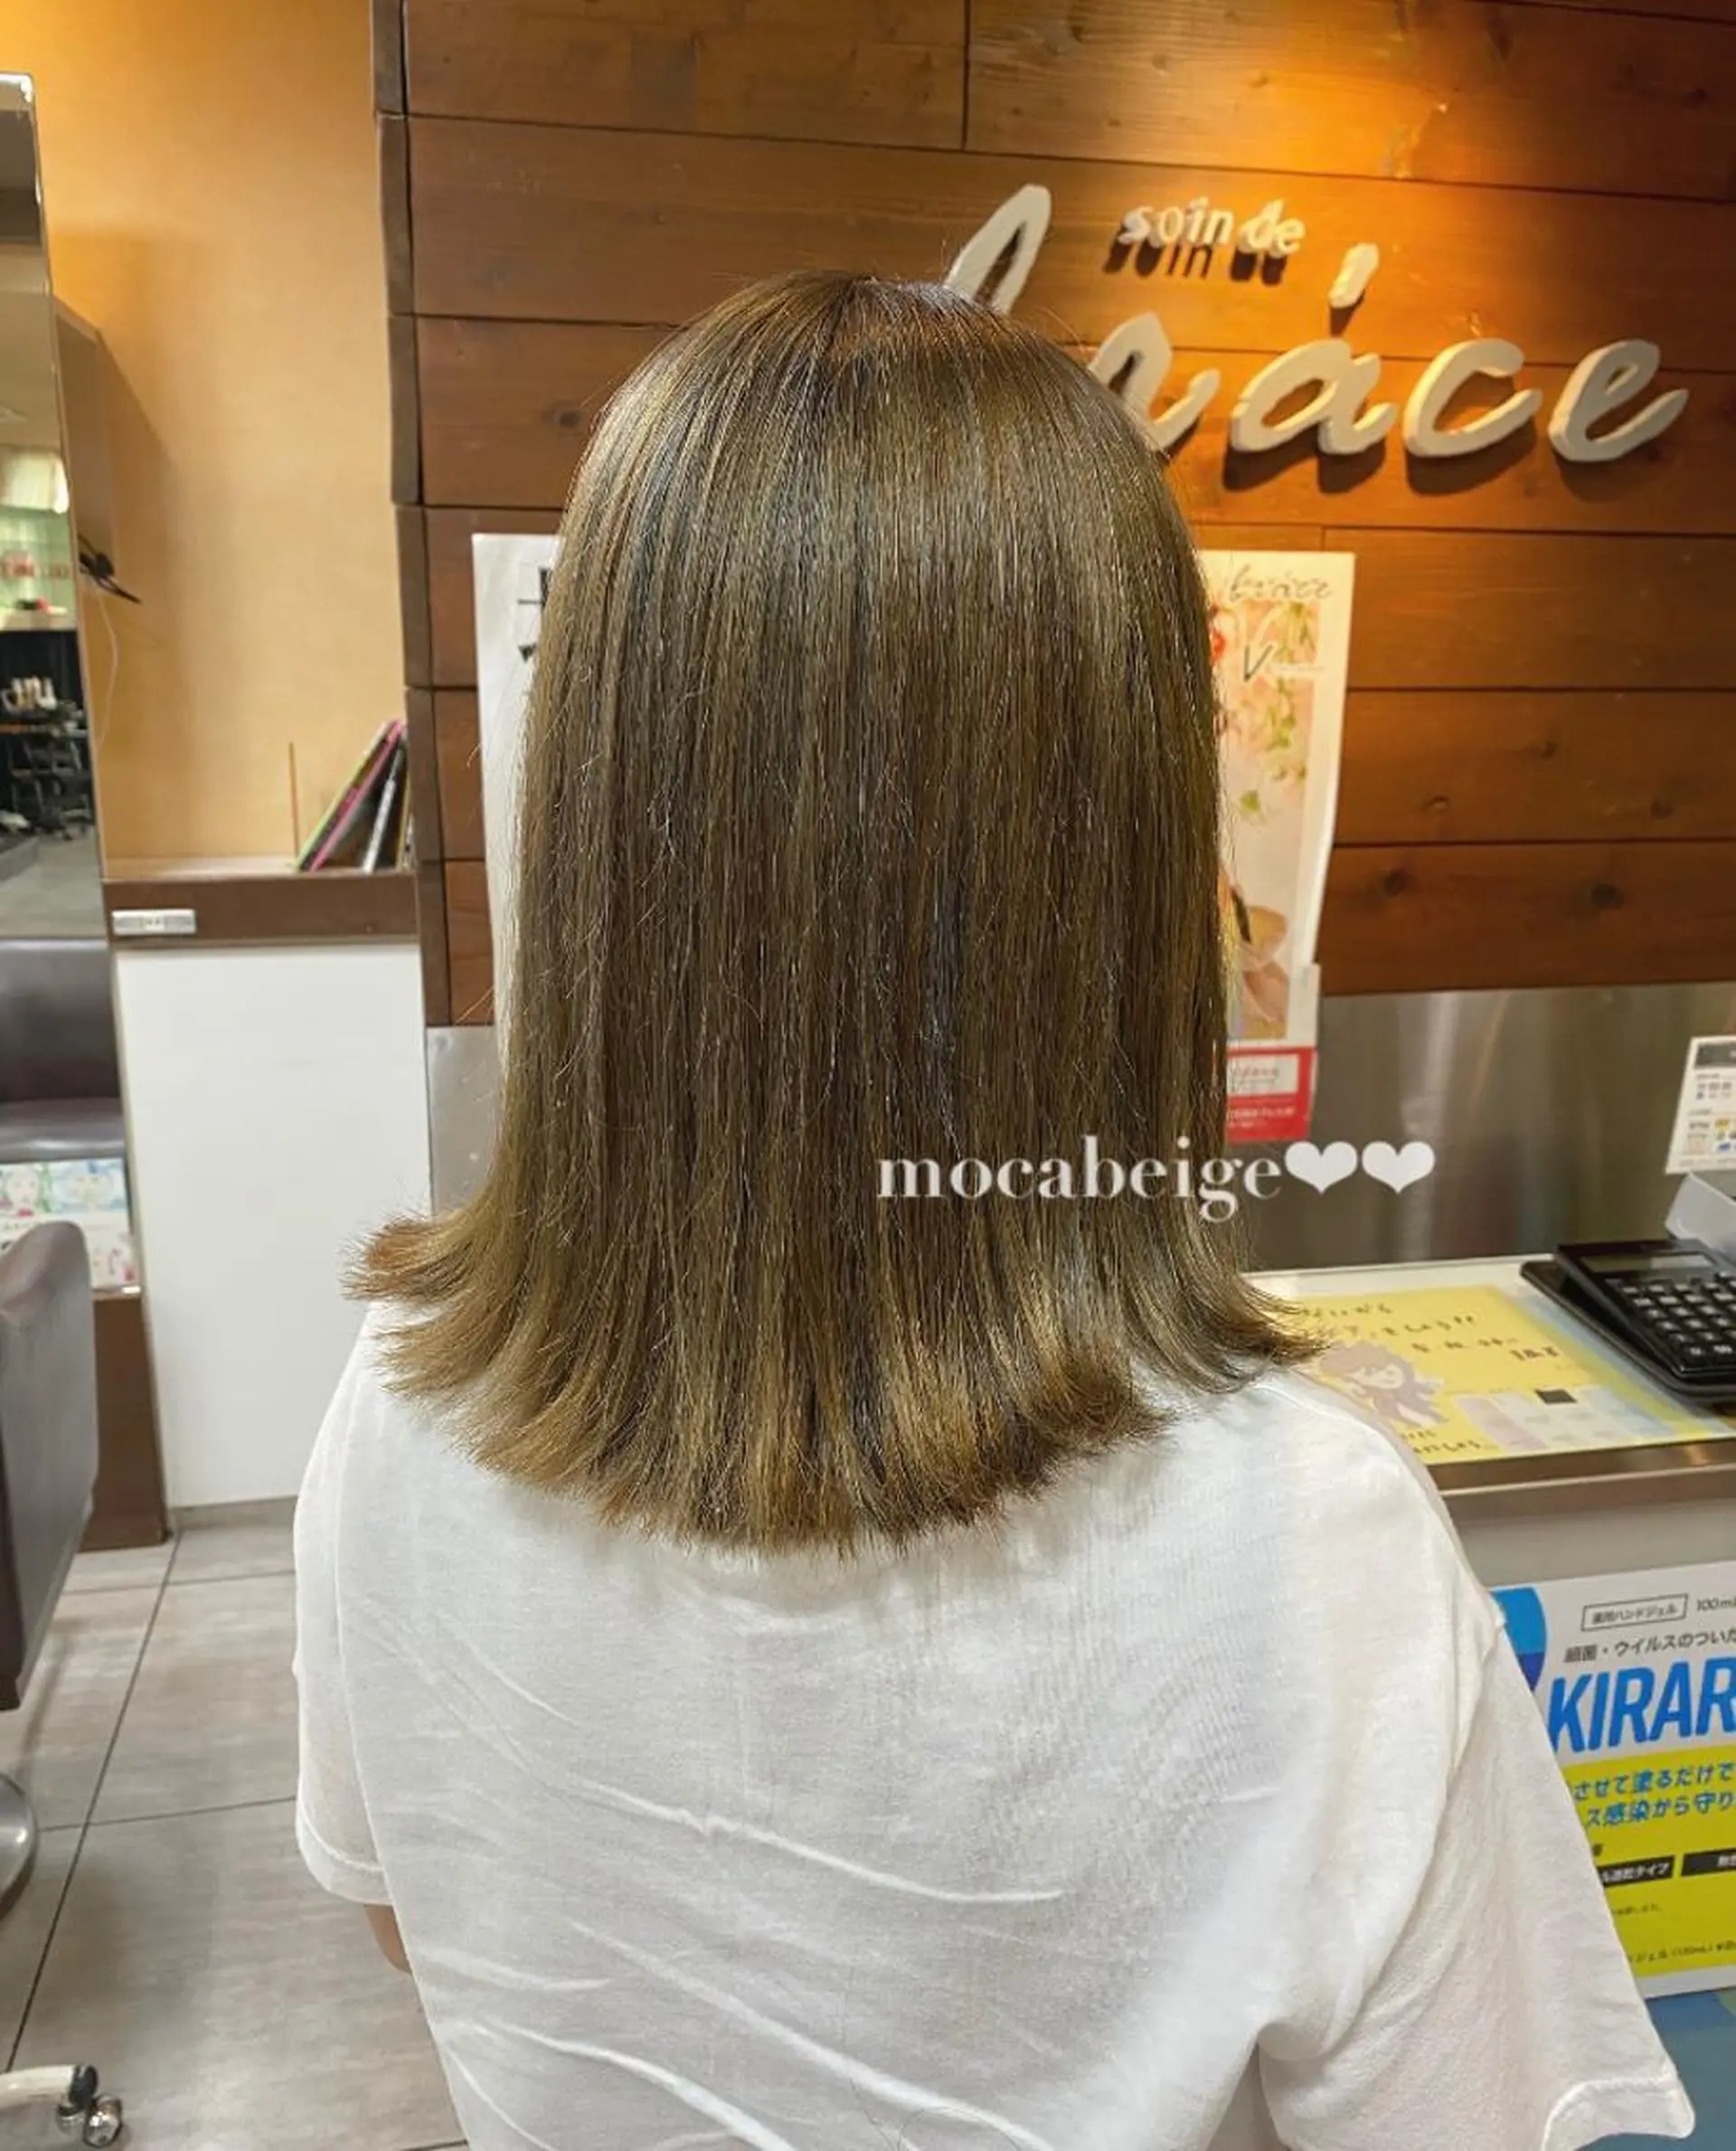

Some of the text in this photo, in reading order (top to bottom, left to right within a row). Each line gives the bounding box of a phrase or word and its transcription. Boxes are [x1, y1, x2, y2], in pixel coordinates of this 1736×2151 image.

[1118, 196, 1307, 259] soin de
[1547, 1656, 1736, 1753] KIRAR
